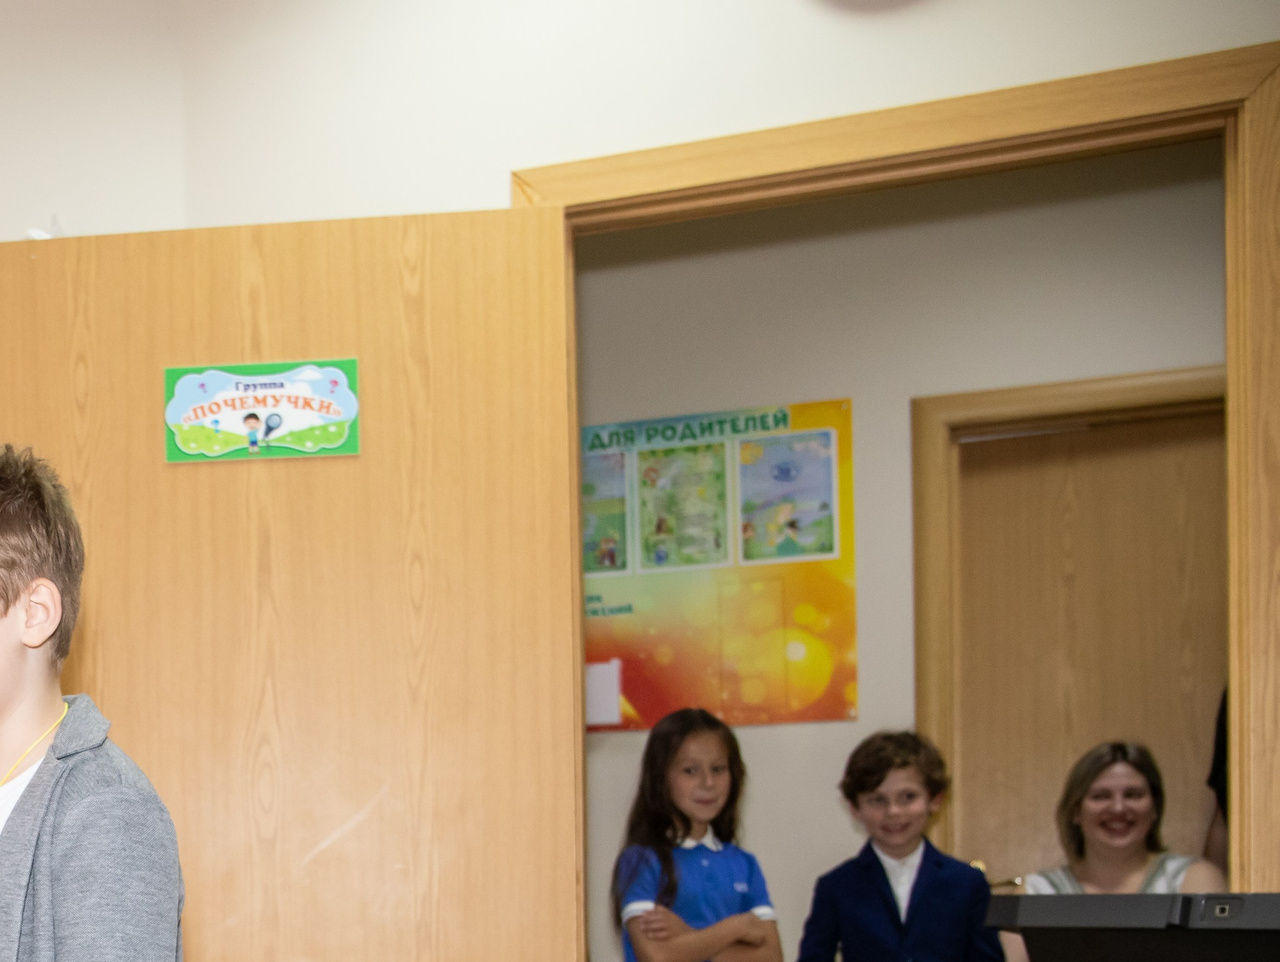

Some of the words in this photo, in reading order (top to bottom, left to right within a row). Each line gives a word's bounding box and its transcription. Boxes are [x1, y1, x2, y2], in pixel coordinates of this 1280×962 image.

[235, 381, 285, 392] Группа
[182, 394, 342, 424] «ПОЧЕМУЧКИ»
[588, 429, 636, 451] ДЛЯ
[645, 407, 789, 443] РОДИТЕЛЕЙ
